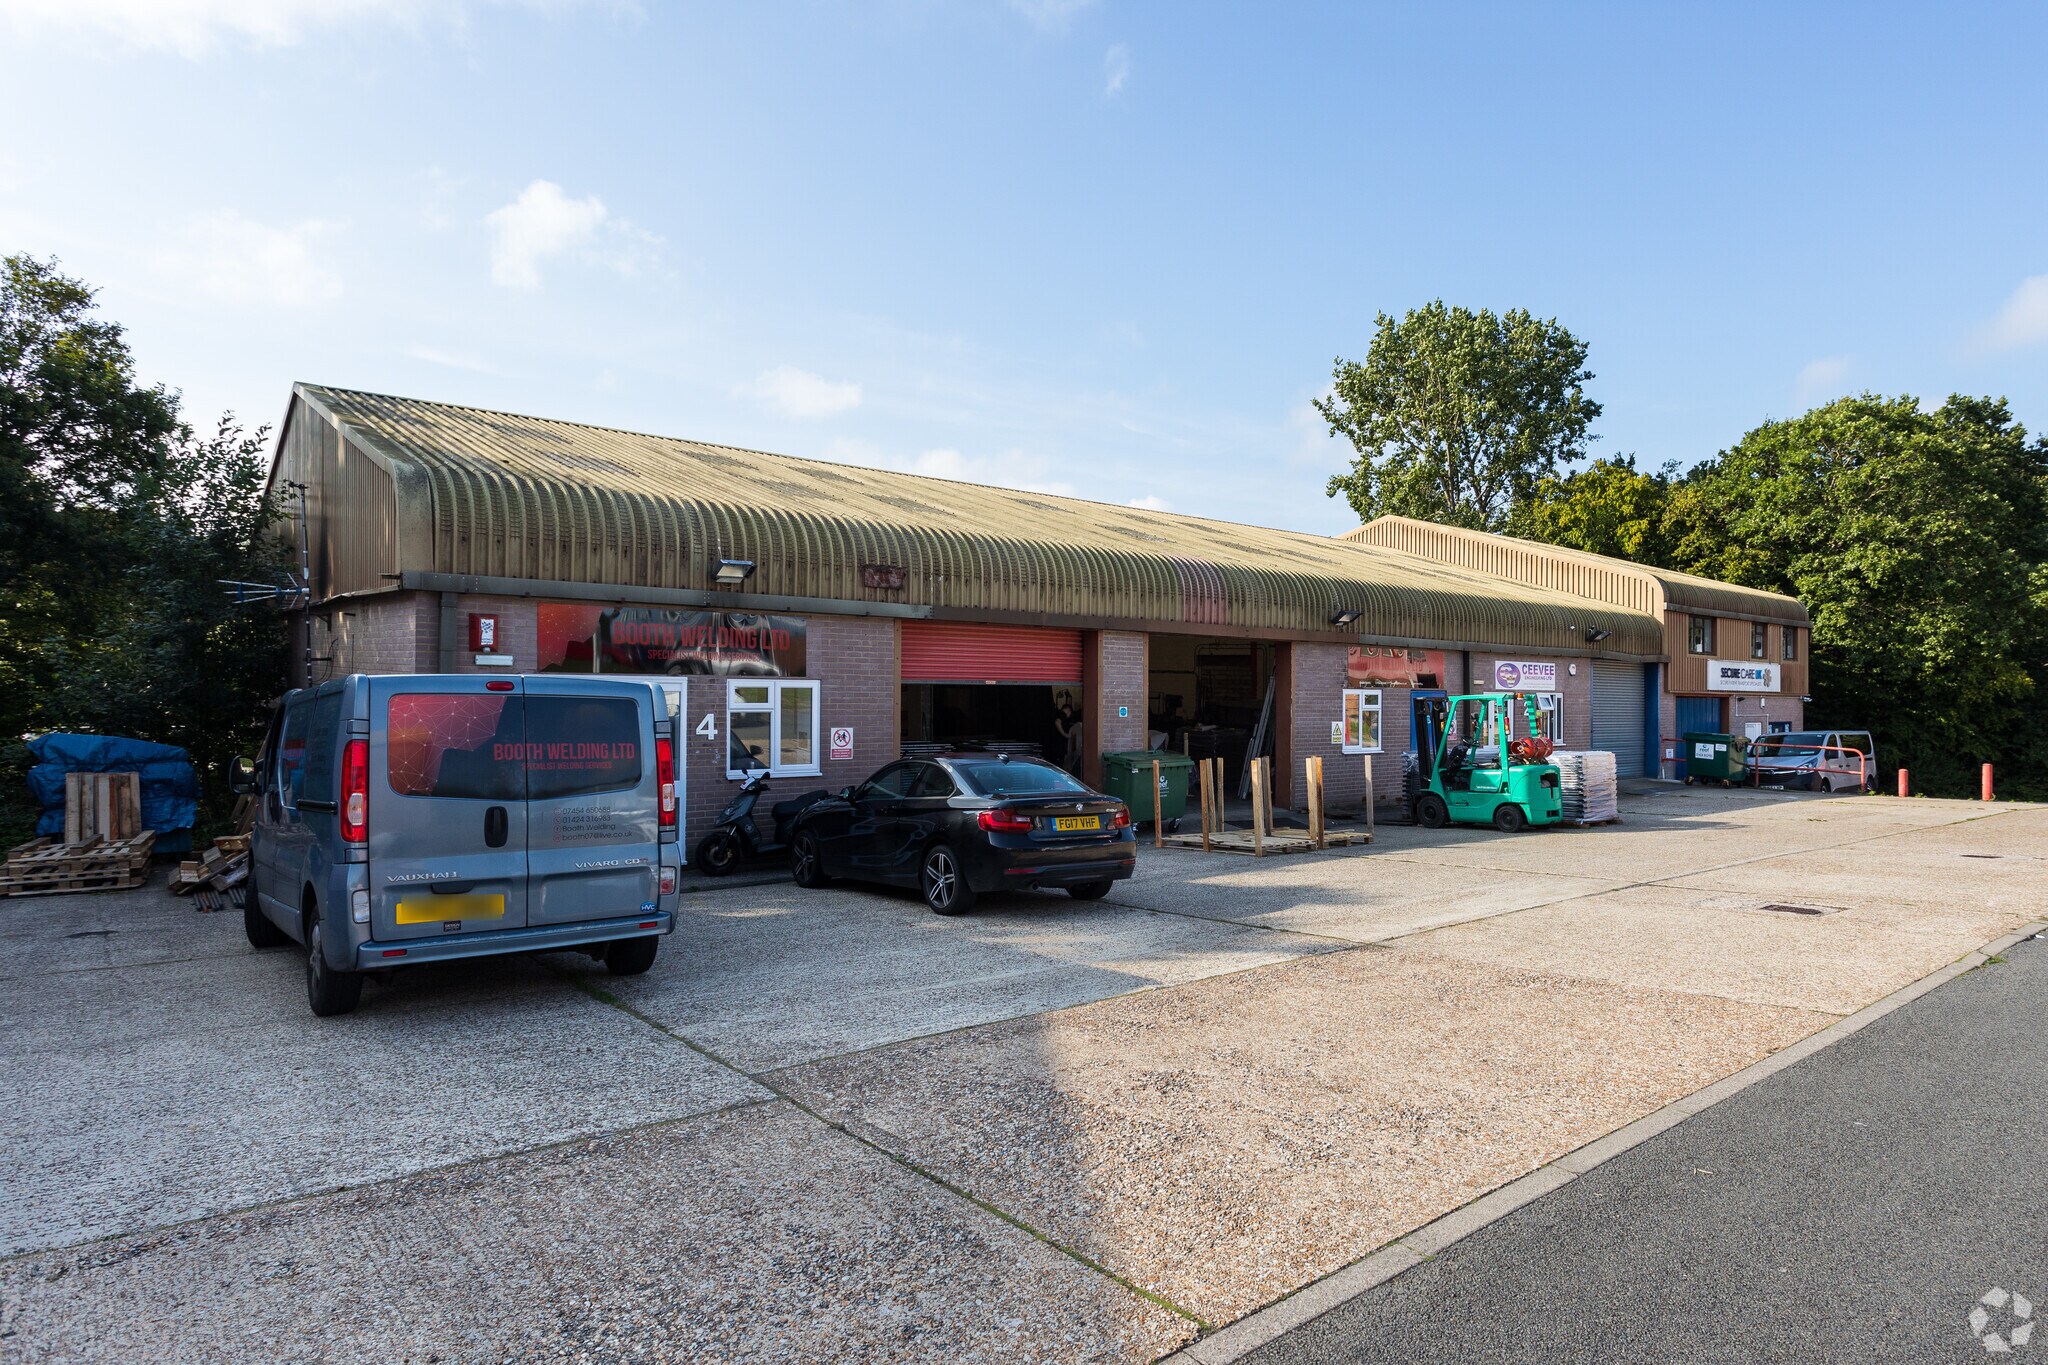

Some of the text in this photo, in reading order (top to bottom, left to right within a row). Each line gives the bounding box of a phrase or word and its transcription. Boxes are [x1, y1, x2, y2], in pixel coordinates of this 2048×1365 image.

[613, 621, 790, 650] BOOTH WELDING LTD
[647, 649, 691, 660] SPECIALIST
[1522, 664, 1555, 676] CEEVEE
[696, 713, 718, 740] 4
[493, 742, 635, 760] BOOTH WELDING LTD
[562, 807, 584, 815] 07454
[562, 816, 584, 824] 01424
[1059, 817, 1096, 829] FG17 VHF
[586, 823, 616, 832] Welding
[562, 831, 633, 841] booth07@live.co.uk
[575, 860, 619, 868] VIVARO
[387, 871, 458, 881] VAUXHALL
